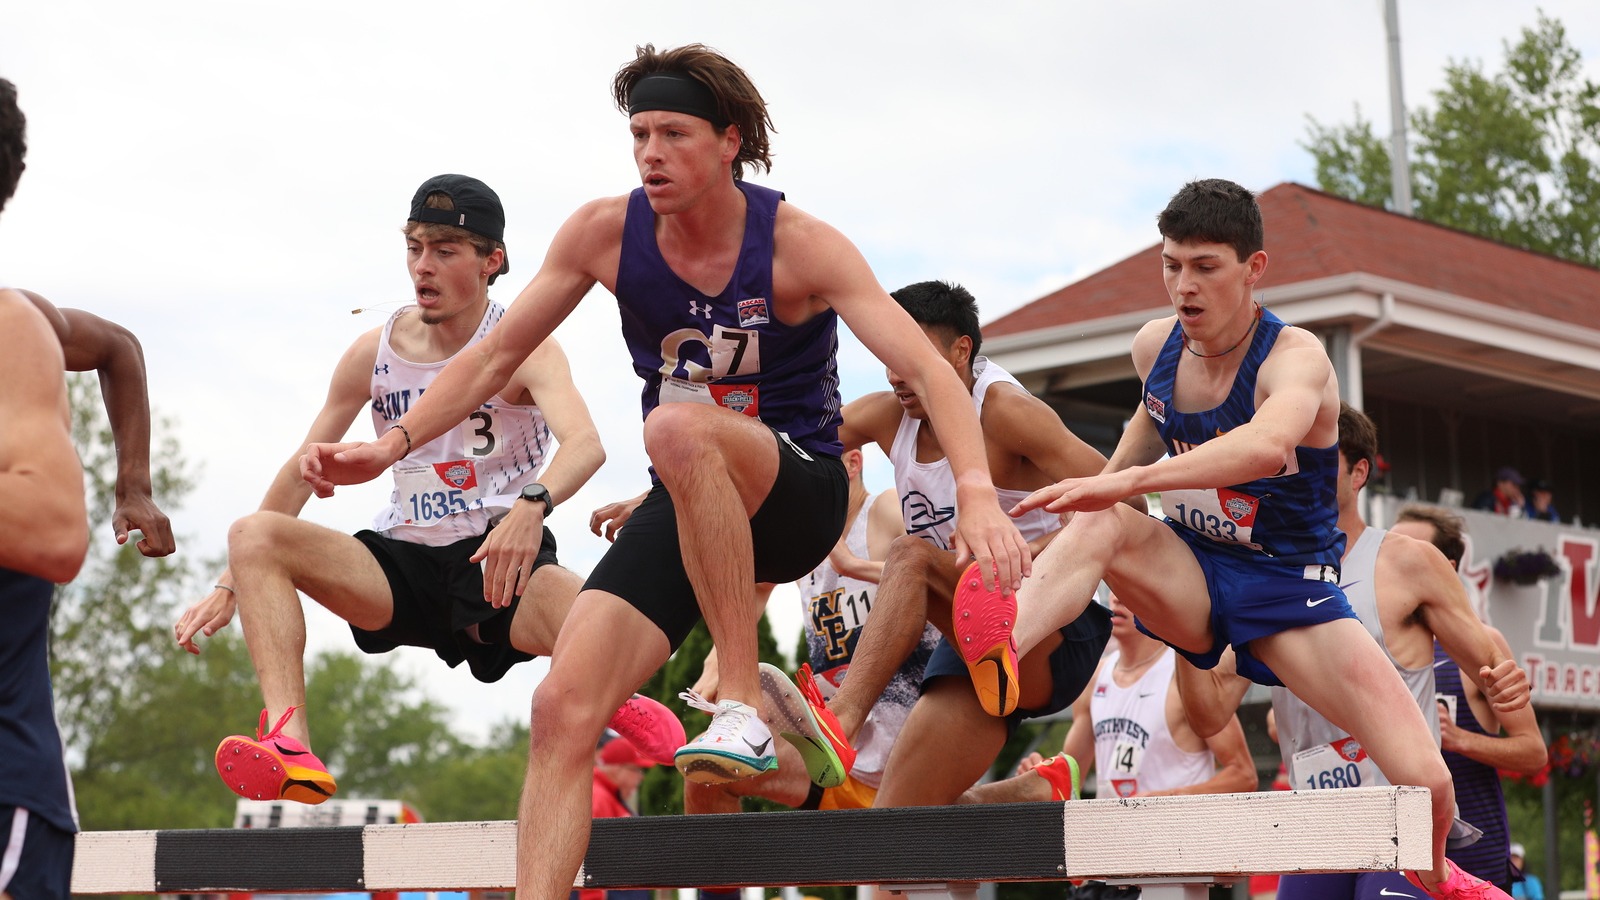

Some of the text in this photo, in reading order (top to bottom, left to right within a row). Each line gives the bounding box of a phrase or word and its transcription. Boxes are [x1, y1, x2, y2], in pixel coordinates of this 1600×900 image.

[721, 331, 749, 375] 7
[469, 411, 496, 457] 3
[409, 489, 466, 522] 1635
[1175, 502, 1238, 542] 1033
[846, 590, 872, 626] 11
[1525, 656, 1600, 695] TRAC
[1115, 744, 1134, 774] 14
[1306, 762, 1362, 790] 1680
